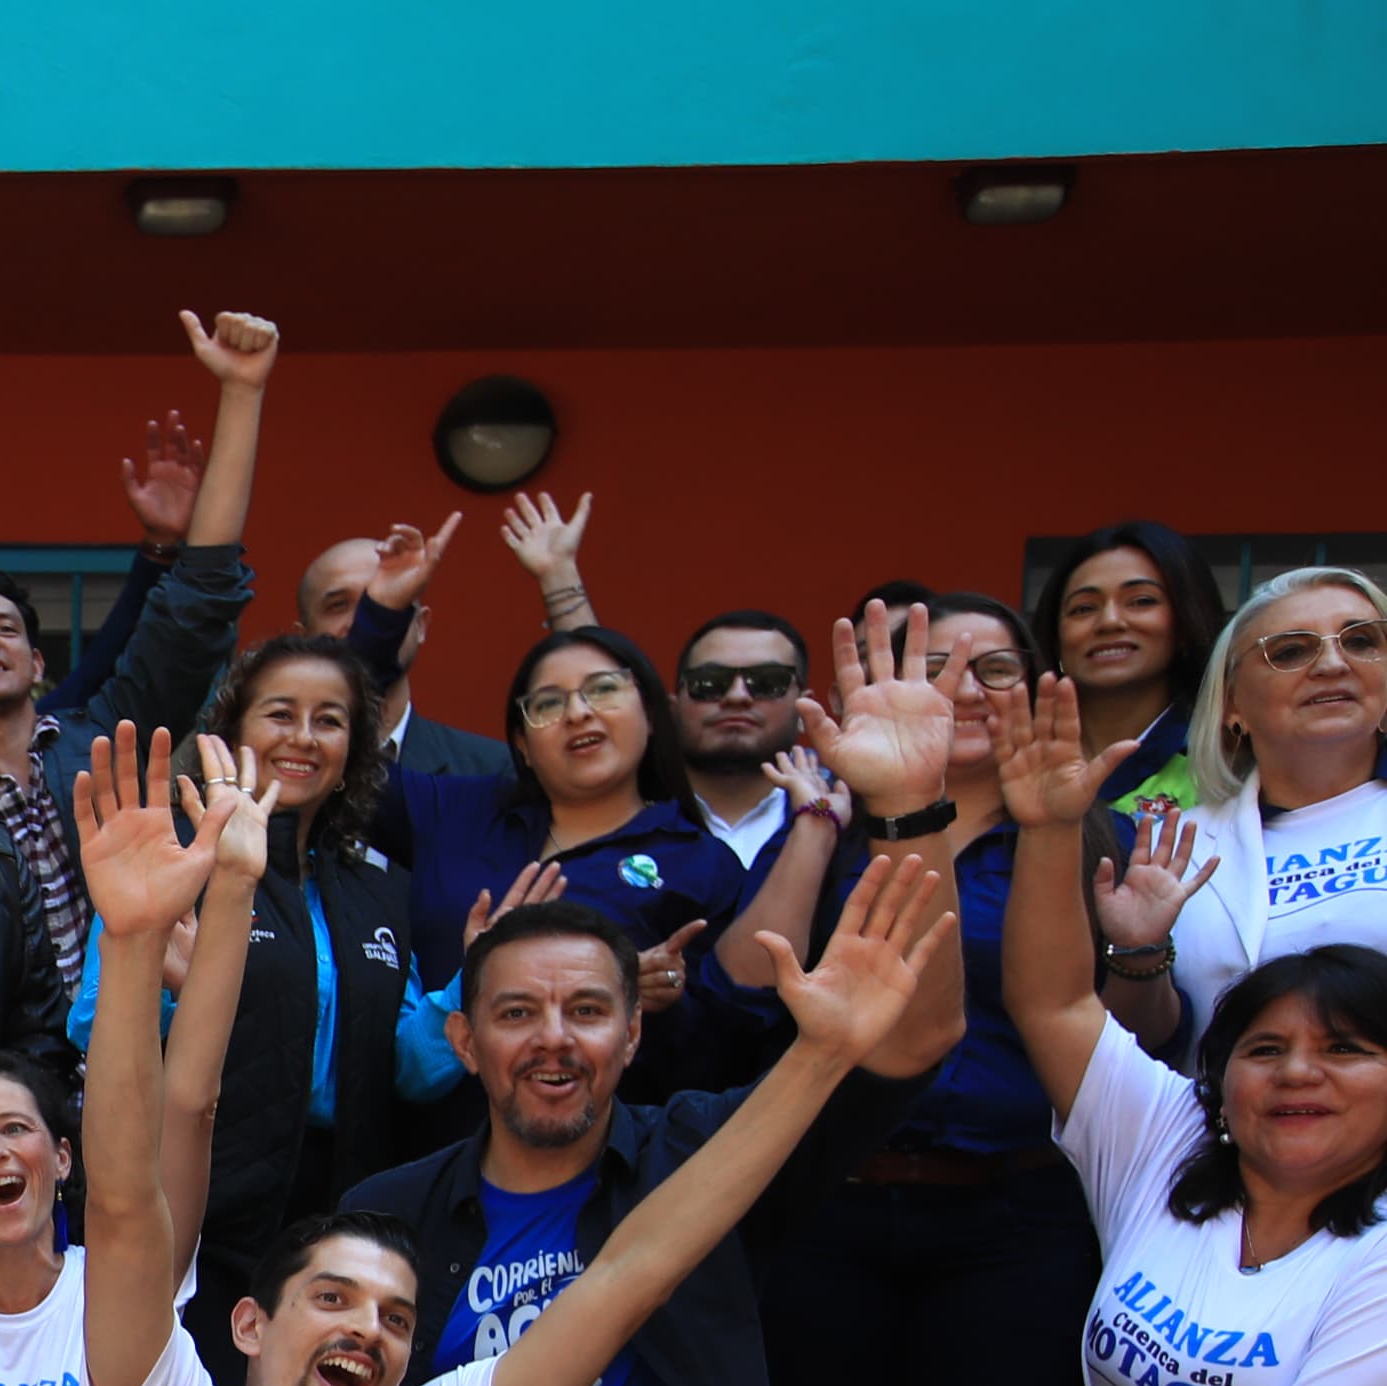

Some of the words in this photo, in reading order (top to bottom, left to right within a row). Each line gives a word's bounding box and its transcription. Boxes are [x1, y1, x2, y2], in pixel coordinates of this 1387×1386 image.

[1269, 867, 1335, 886] enca
[1346, 857, 1380, 871] del
[513, 1287, 539, 1308] POR
[1113, 1271, 1280, 1368] ALIANZA
[1112, 1311, 1181, 1376] Cuenca
